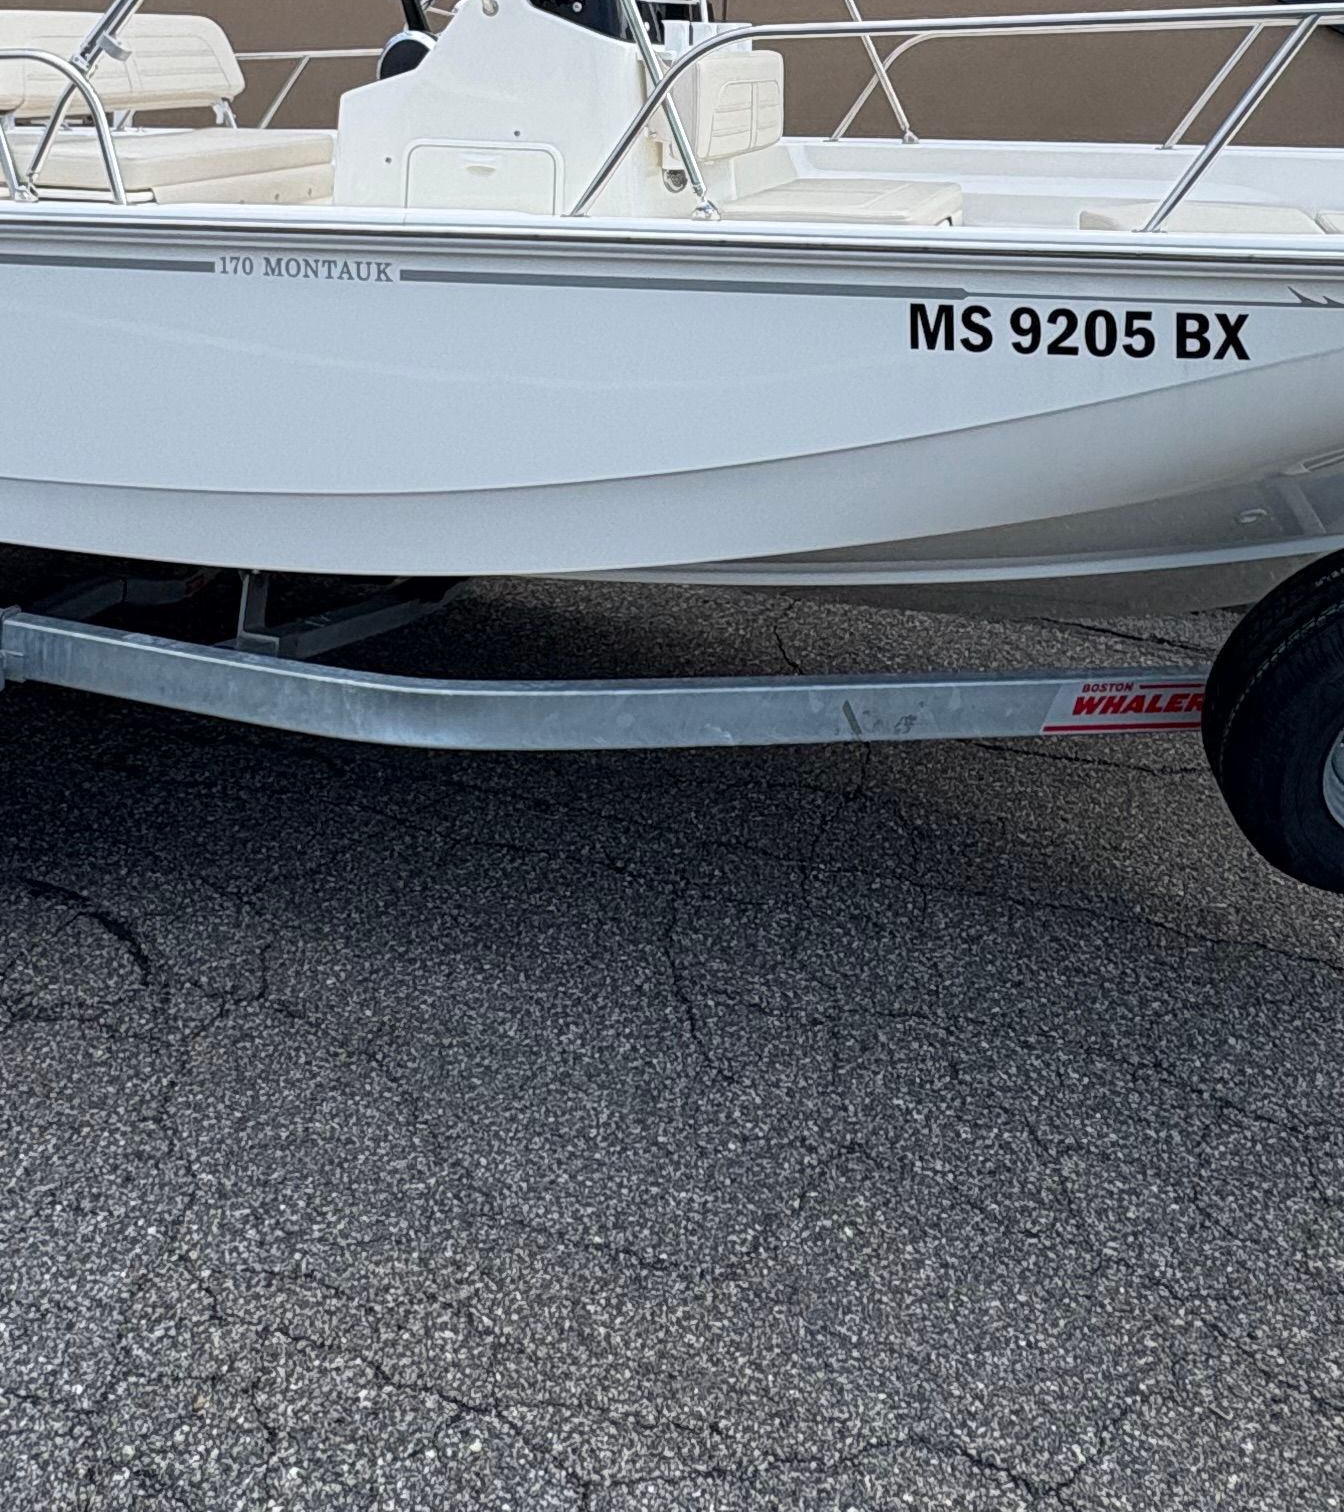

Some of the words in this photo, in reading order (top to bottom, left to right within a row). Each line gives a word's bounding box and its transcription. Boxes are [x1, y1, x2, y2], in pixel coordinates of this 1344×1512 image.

[219, 256, 254, 276] 170
[263, 257, 394, 283] MONTAUK
[909, 303, 994, 353] MS
[1009, 306, 1157, 359] 9205
[1175, 311, 1252, 361] BX
[1081, 682, 1135, 694] BOSTON
[1072, 693, 1206, 716] WHALER
